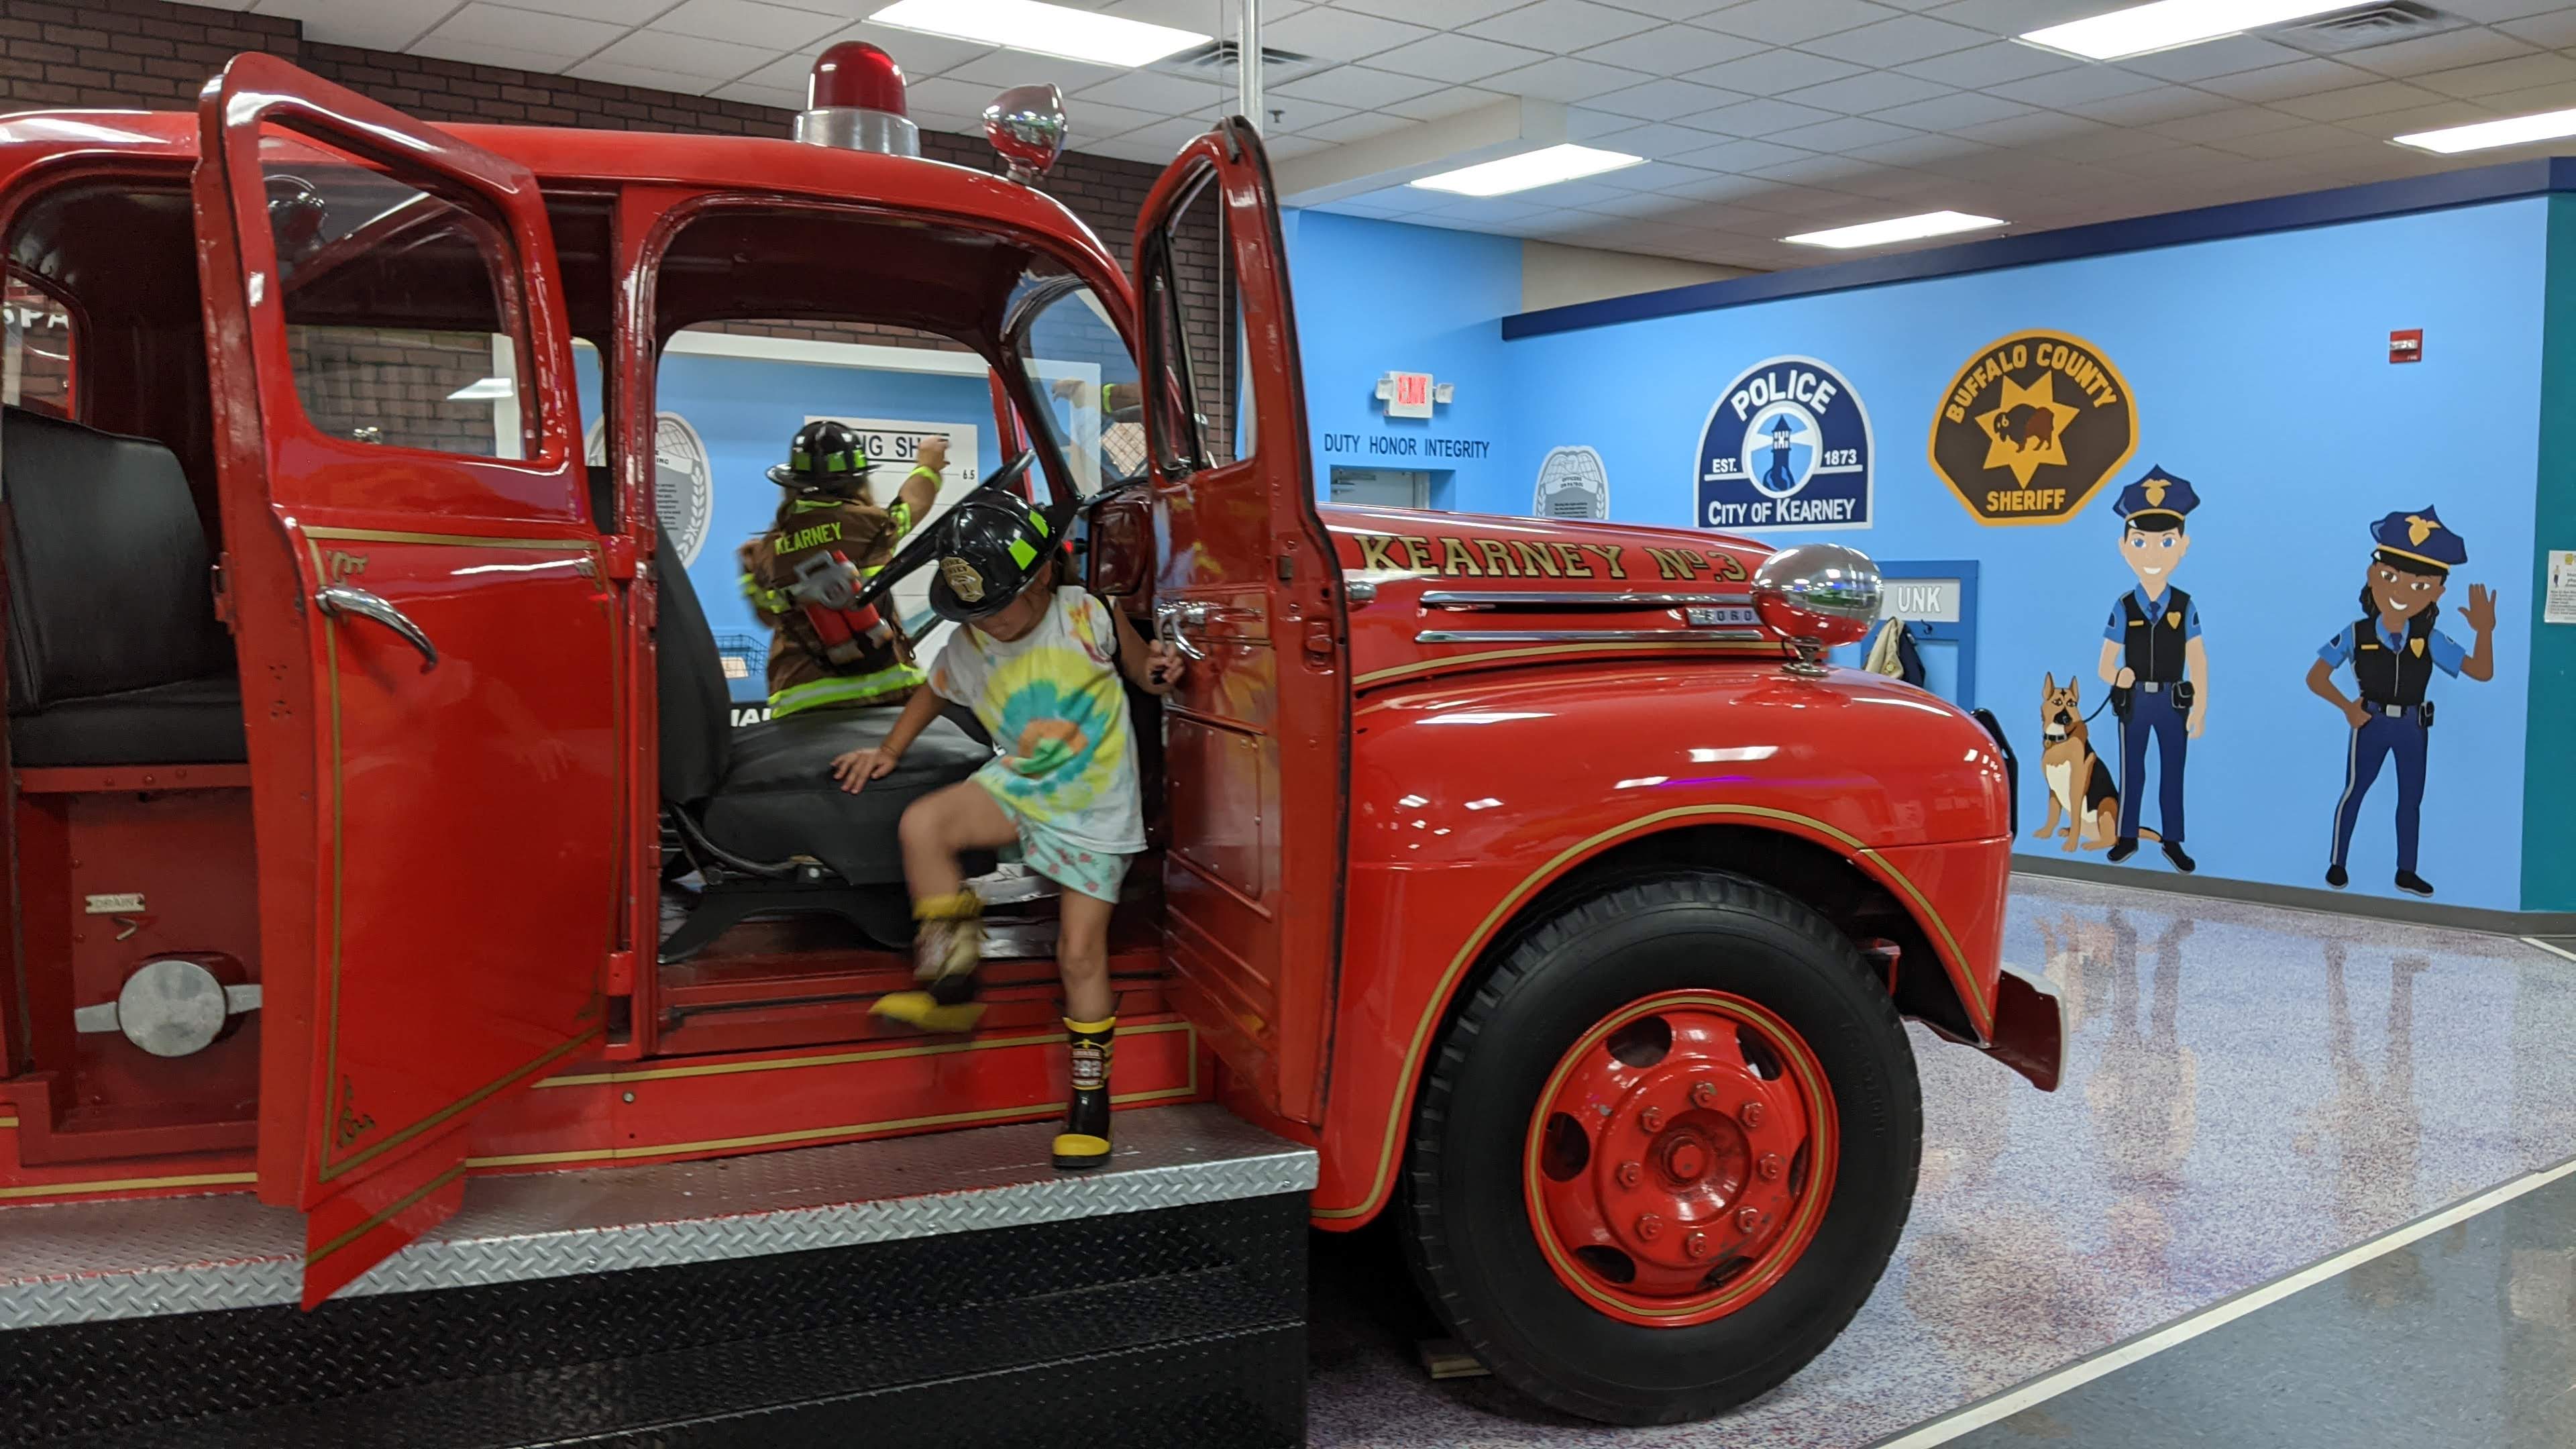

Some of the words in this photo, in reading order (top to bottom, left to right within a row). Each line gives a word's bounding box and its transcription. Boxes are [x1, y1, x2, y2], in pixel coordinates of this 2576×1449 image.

[1731, 370, 1837, 422] POLICE
[1945, 344, 2027, 424] BUFFALO
[2037, 343, 2117, 408] COUNTY
[1324, 434, 1360, 453] DUTY
[1370, 436, 1417, 455] HONOR
[1425, 439, 1490, 459] INTEGRITY
[1713, 458, 1737, 473] EST.
[1825, 449, 1857, 465] 1873
[963, 470, 975, 480] 6.5
[1752, 502, 1772, 523] OF
[1776, 498, 1856, 522] KEARNEY
[1986, 489, 2065, 511] SHERIFF
[775, 522, 842, 555] KEARNEY
[1354, 535, 1627, 579] KEARNEY
[1897, 586, 1942, 612] UNK
[1705, 610, 1752, 621] FORD
